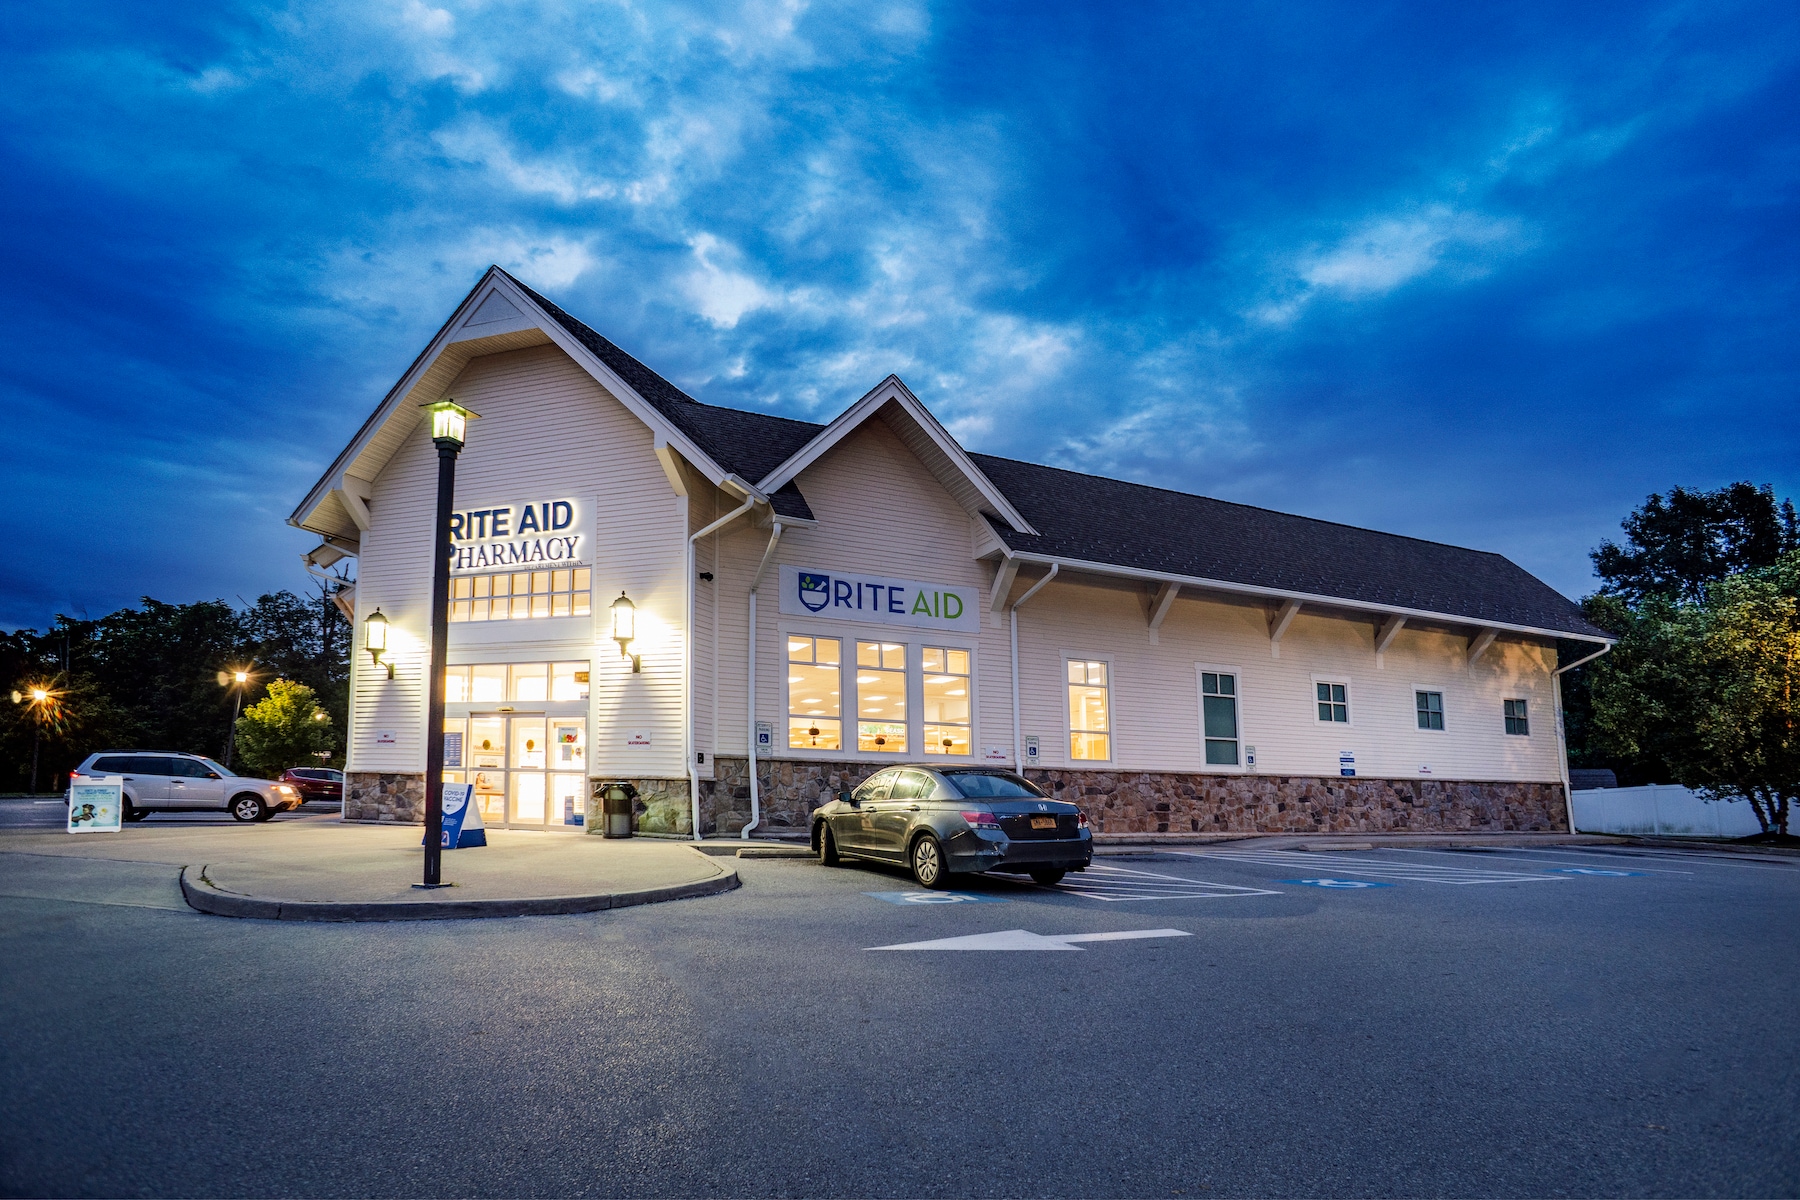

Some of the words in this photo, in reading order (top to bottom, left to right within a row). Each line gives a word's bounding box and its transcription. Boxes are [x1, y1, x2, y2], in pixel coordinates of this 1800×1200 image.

[449, 508, 511, 541] RITE
[518, 501, 573, 534] AID
[524, 562, 560, 571] DEPARTMENT
[561, 559, 583, 567] WITHIN
[834, 579, 906, 614] RITE
[910, 589, 964, 619] AID
[444, 789, 465, 797] COVID-19
